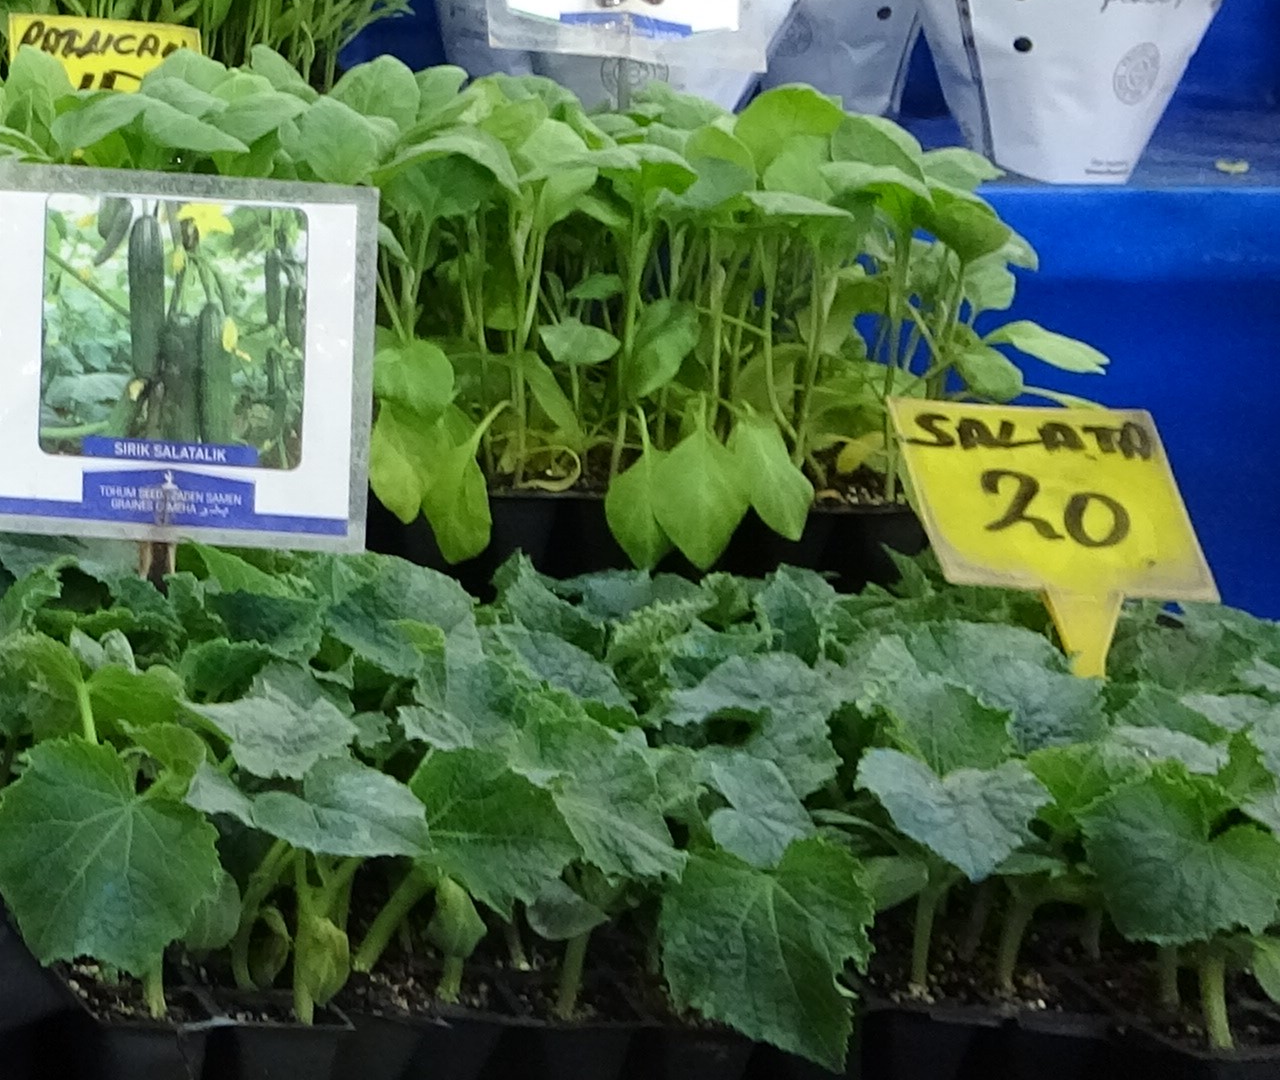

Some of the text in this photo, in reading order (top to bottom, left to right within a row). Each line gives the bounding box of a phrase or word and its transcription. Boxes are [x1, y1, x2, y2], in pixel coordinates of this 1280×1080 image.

[114, 441, 227, 463] SIRIK SALATALIK
[906, 413, 1153, 461] SALATA
[981, 469, 1131, 548] 20
